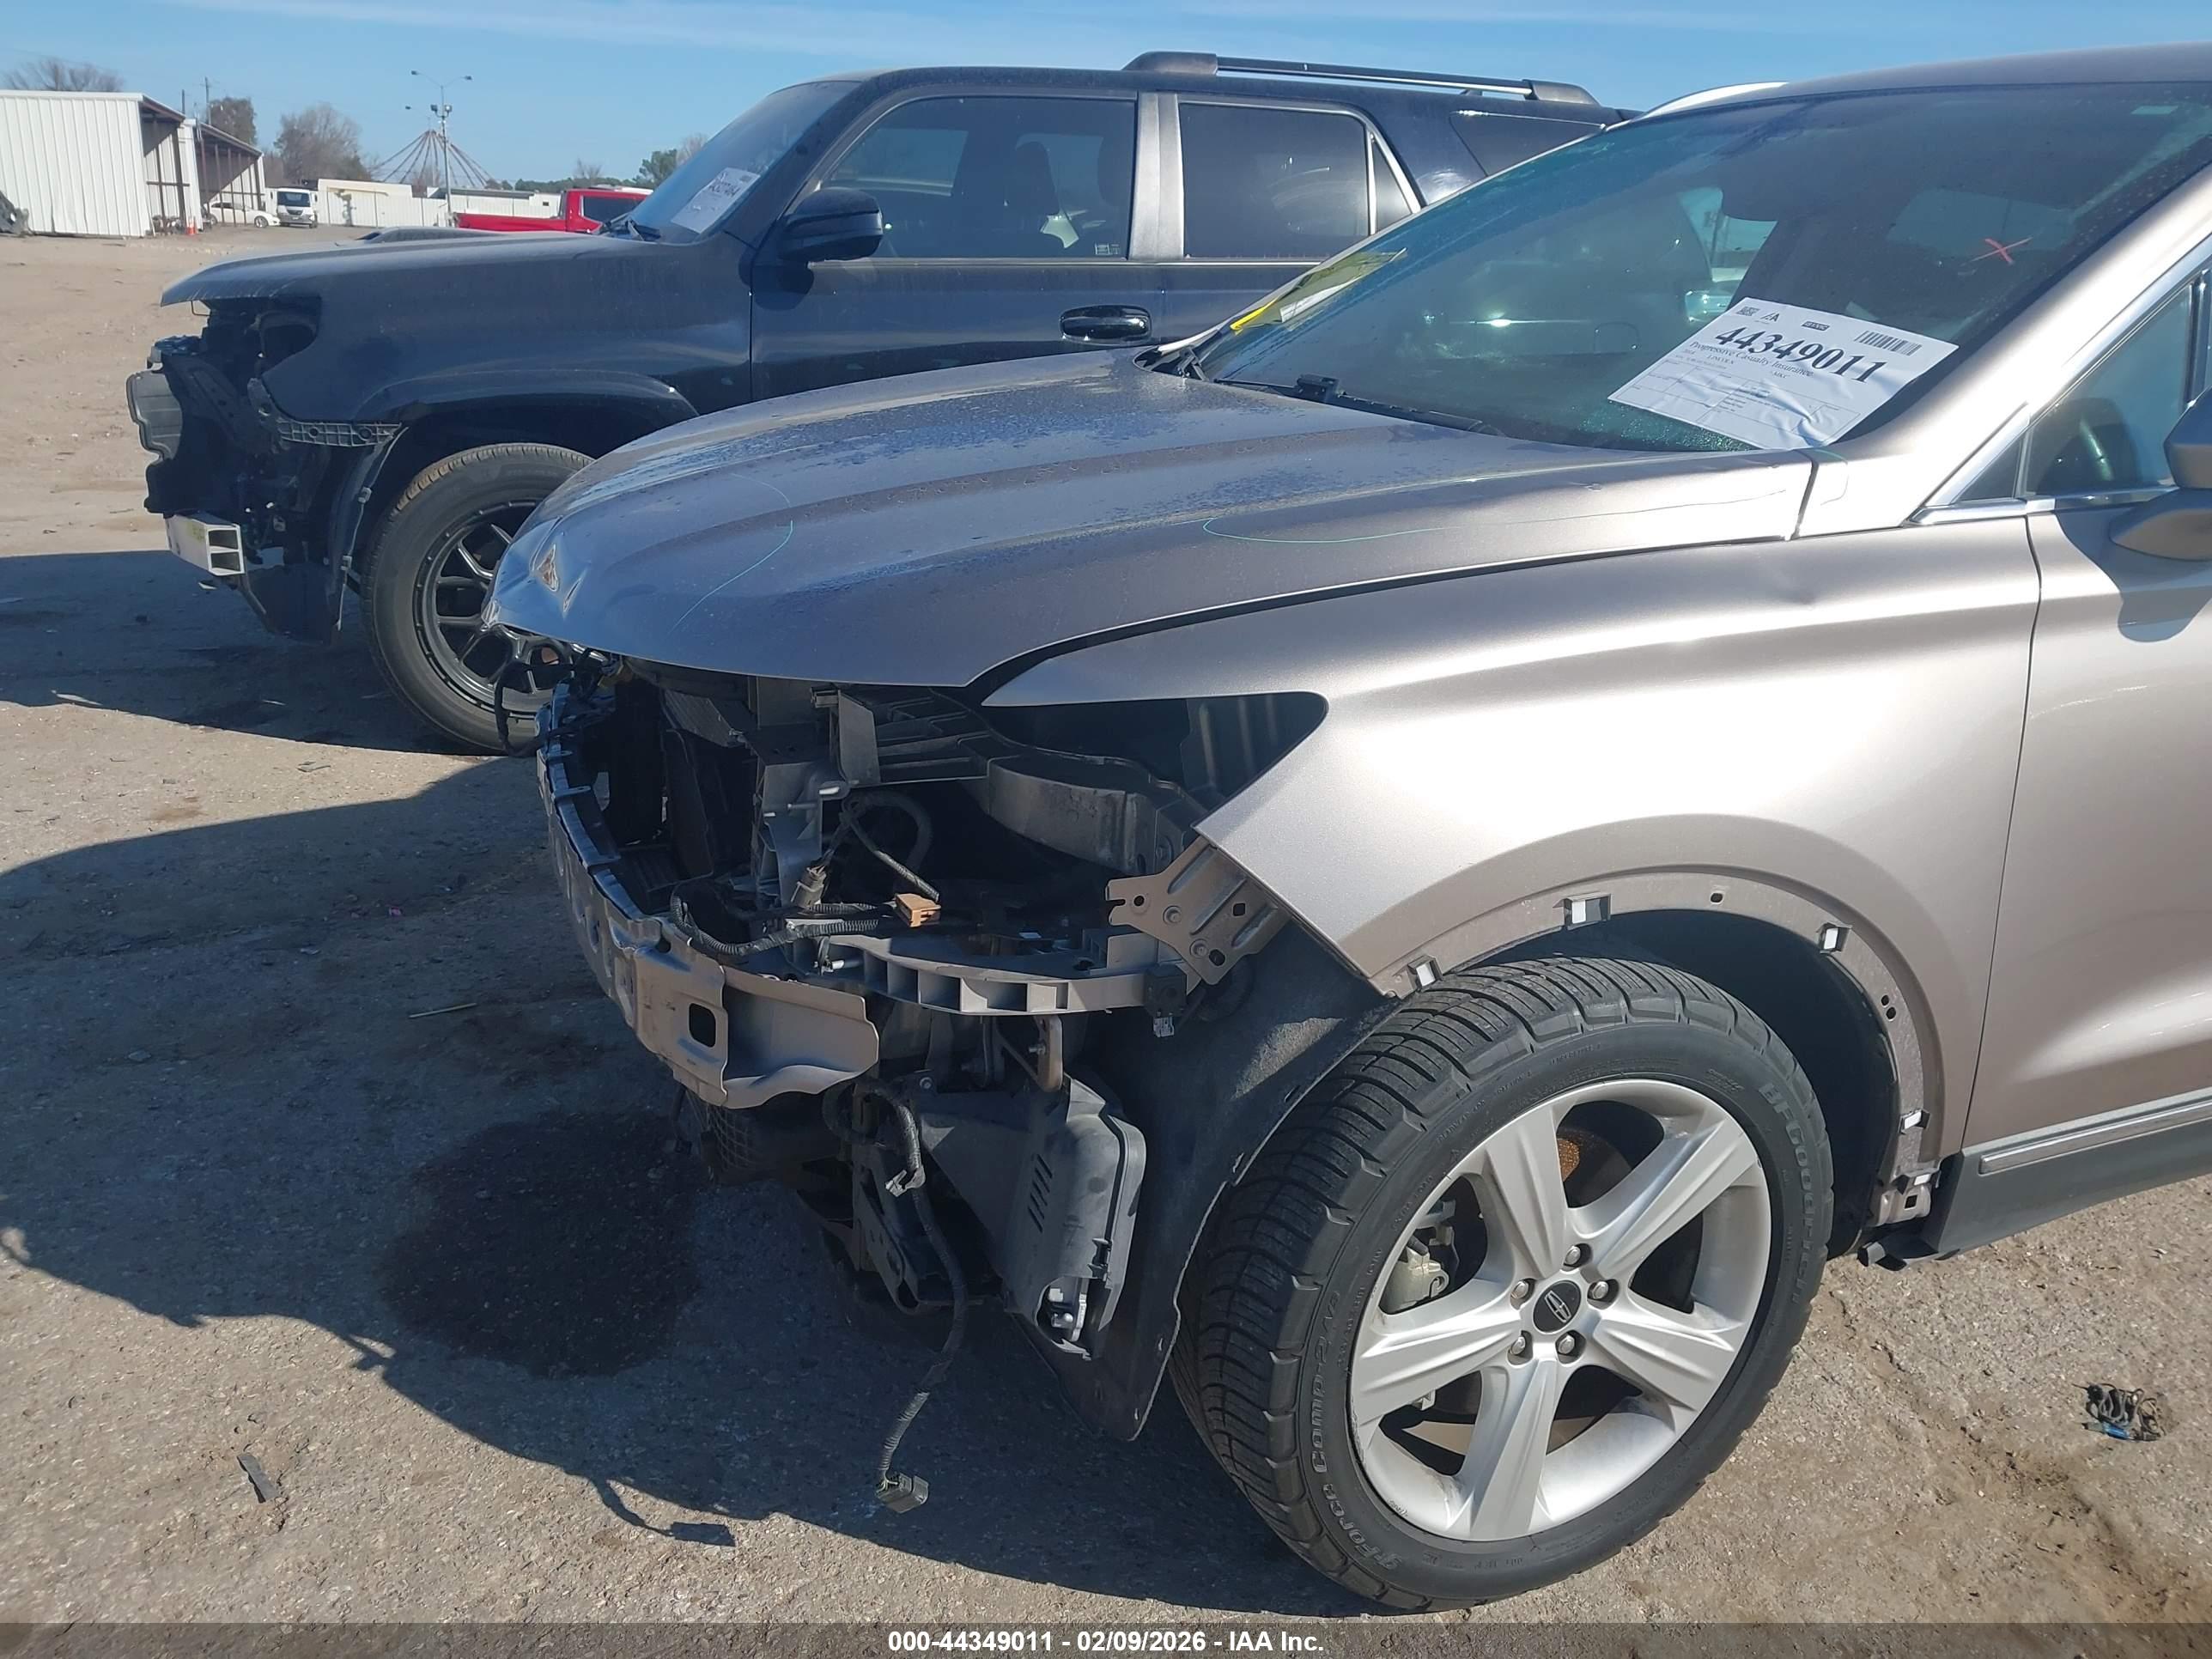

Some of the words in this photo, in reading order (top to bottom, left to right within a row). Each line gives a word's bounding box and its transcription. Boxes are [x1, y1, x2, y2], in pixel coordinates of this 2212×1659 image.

[1690, 341, 1735, 357] Progressive
[1735, 349, 1771, 366] Casualty
[1771, 359, 1814, 377] Insurance
[1715, 326, 1888, 384] 44349011
